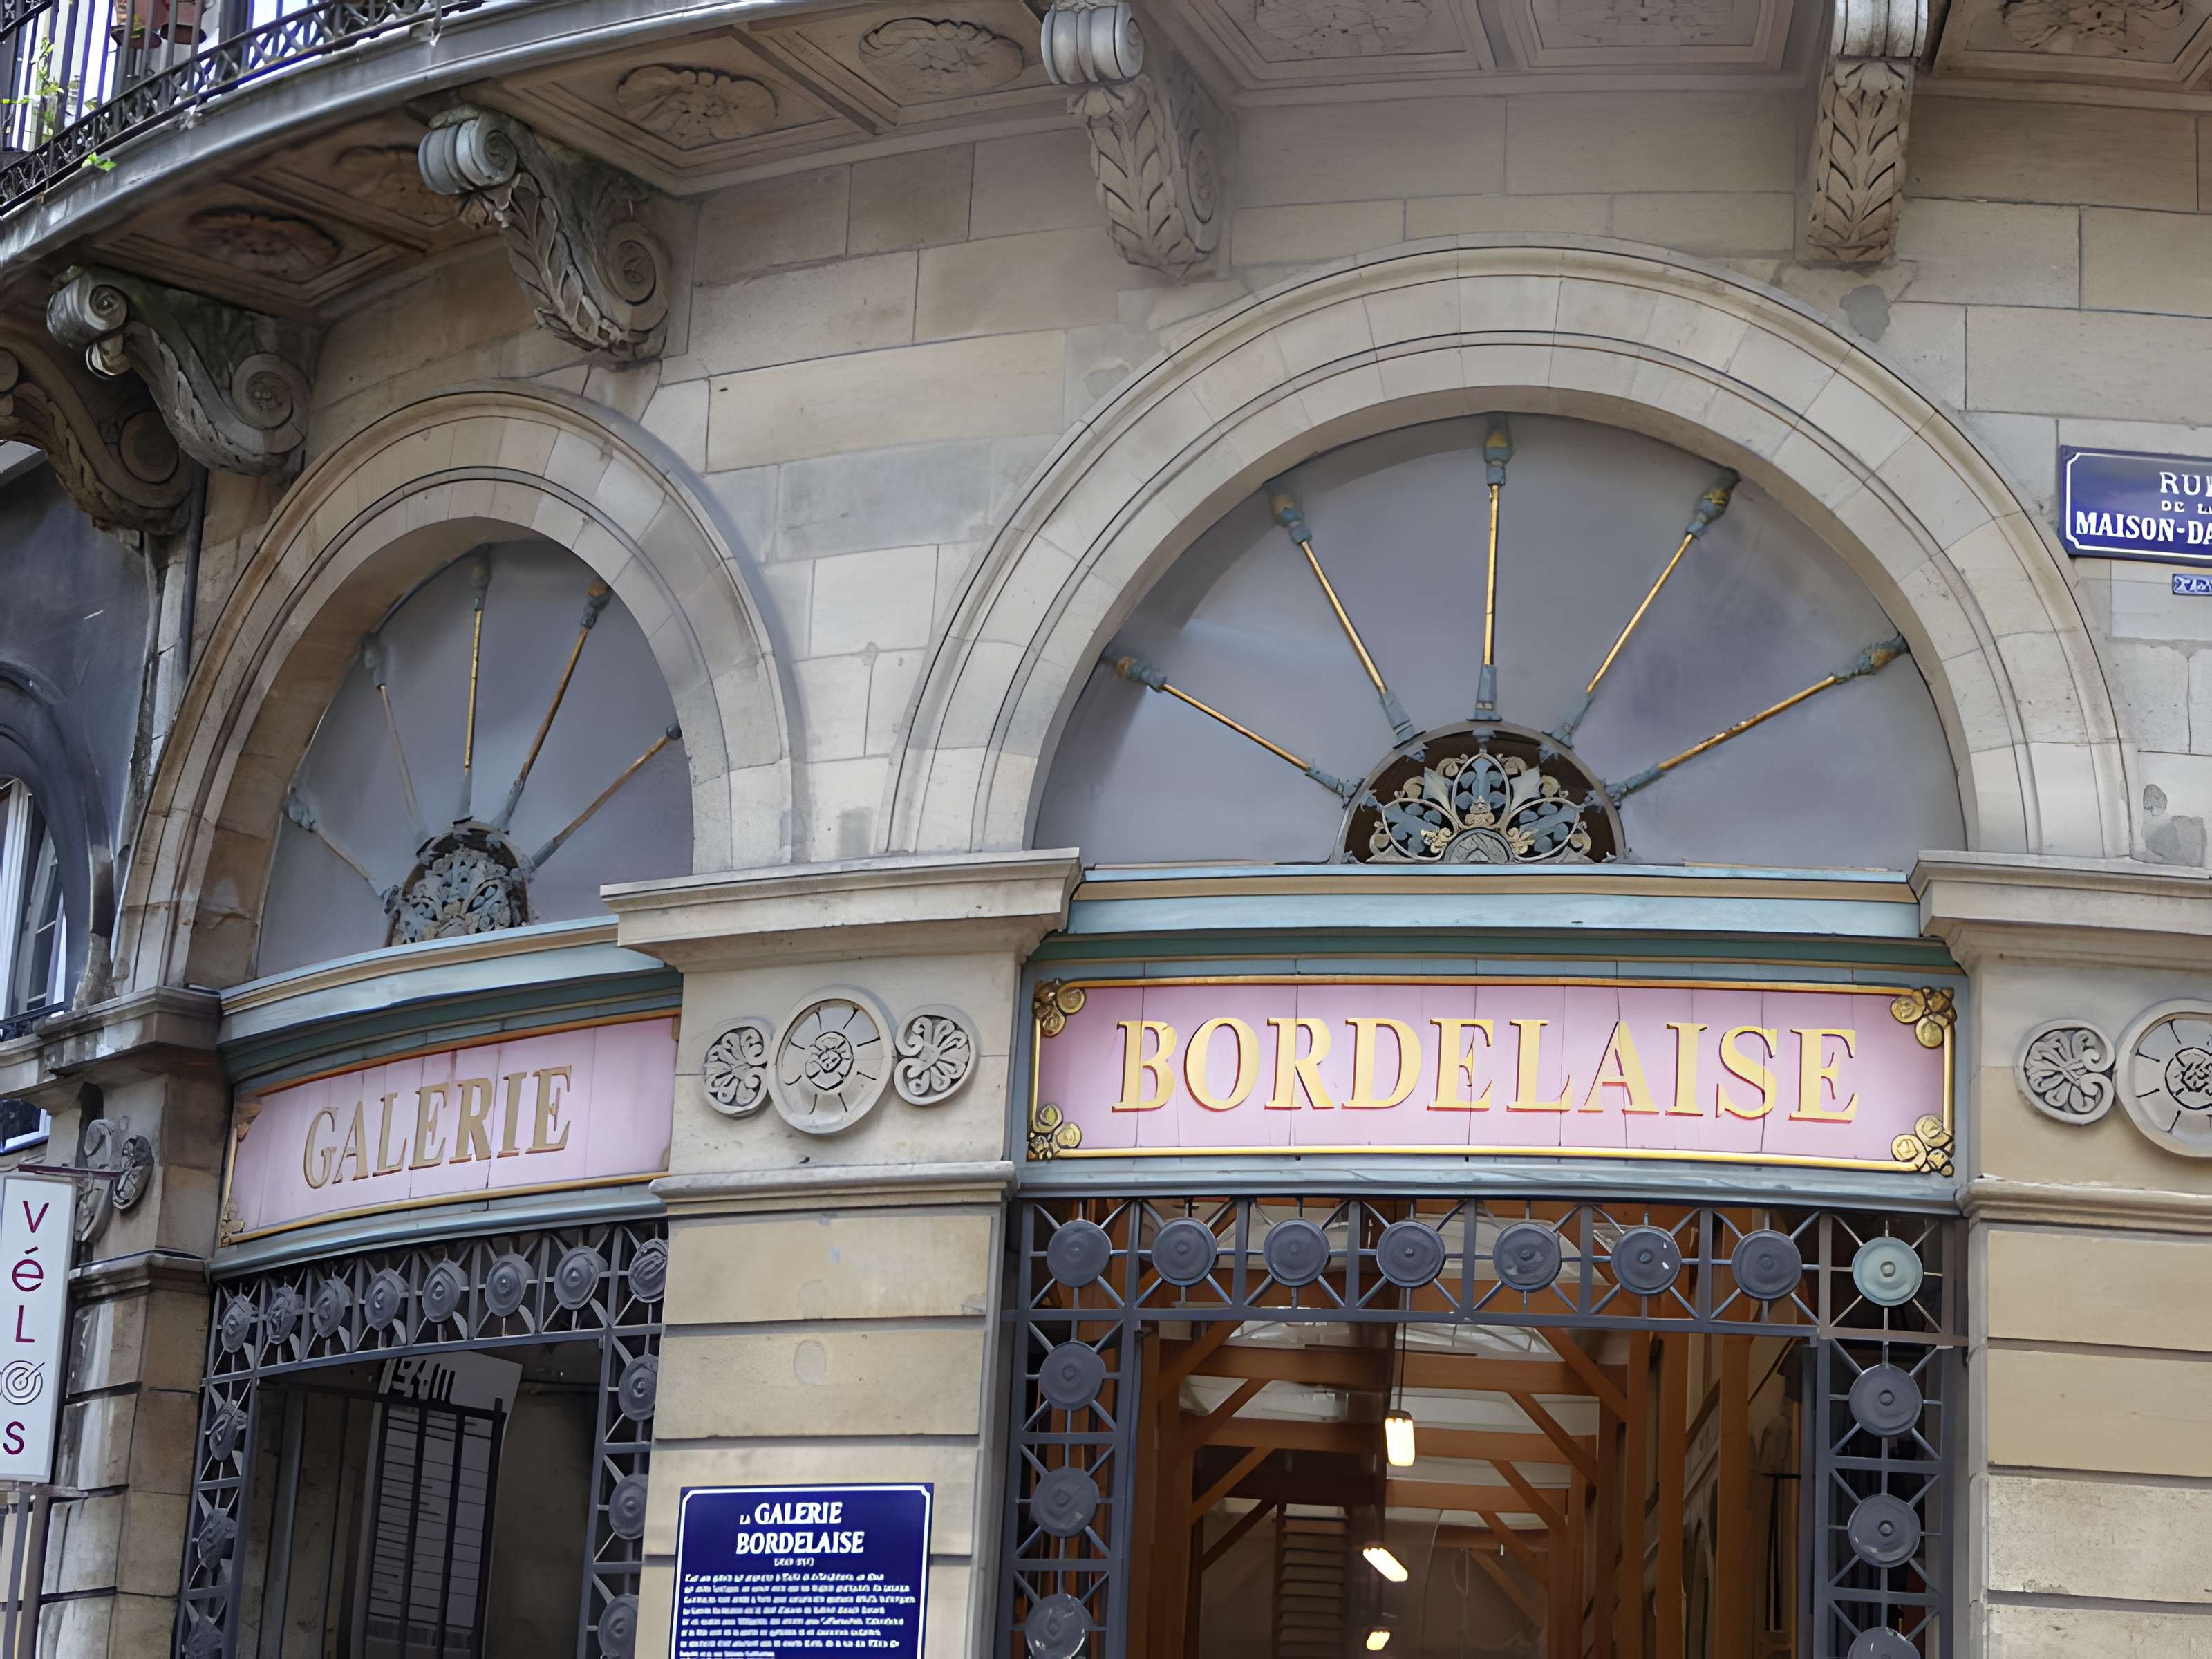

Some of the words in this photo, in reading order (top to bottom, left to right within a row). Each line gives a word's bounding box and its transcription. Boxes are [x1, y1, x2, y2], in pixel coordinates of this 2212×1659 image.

[2161, 500, 2185, 512] DE
[1112, 1018, 1859, 1124] BORDELAISE
[303, 1065, 572, 1189] GALERIE
[754, 1501, 843, 1525] GALERIE
[735, 1531, 865, 1555] BORDELAISE
